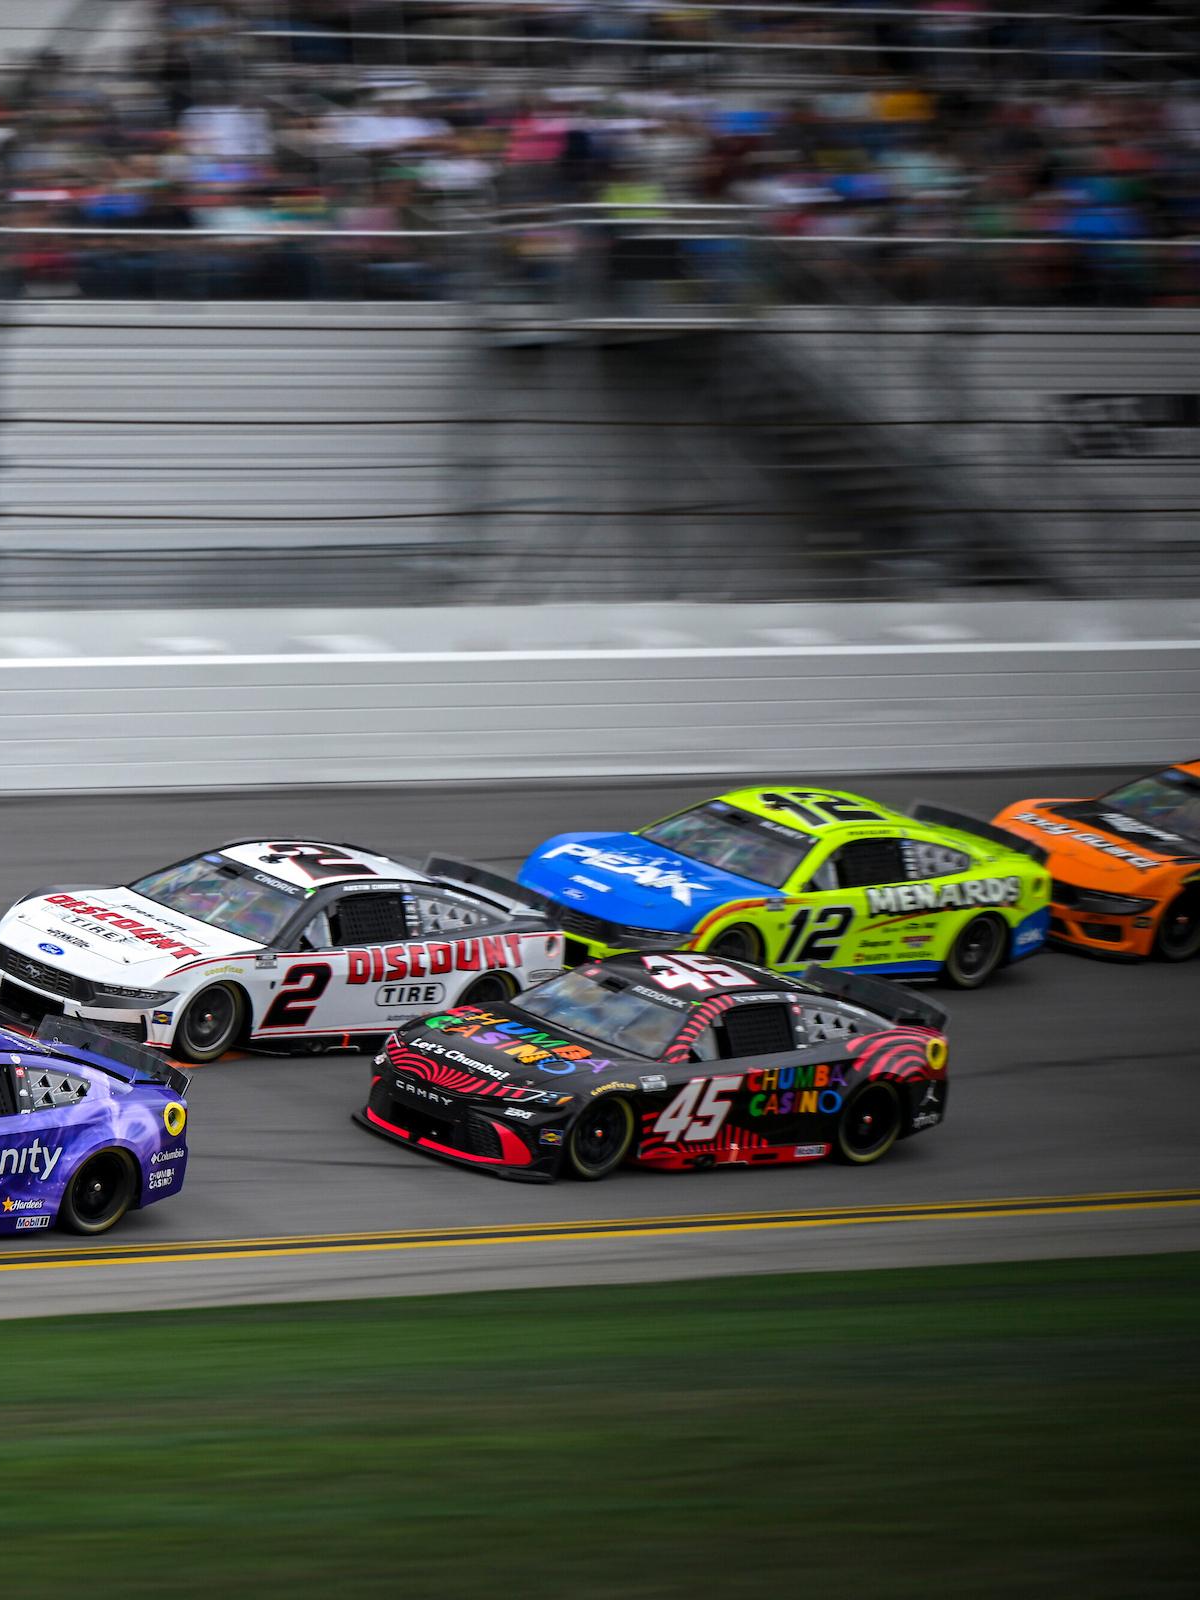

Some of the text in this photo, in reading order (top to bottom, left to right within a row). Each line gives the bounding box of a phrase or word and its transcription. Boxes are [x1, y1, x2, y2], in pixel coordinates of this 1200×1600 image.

[758, 792, 889, 829] 12
[268, 844, 379, 881] 2
[1072, 833, 1161, 870] Guard
[254, 873, 300, 895] CINDRIC
[539, 843, 713, 907] PEAK
[866, 877, 1021, 916] MENARDS
[44, 895, 202, 959] DISCOUNT
[70, 917, 118, 940] TIRE
[121, 904, 187, 931] tires.com
[775, 905, 855, 964] 12
[345, 933, 522, 984] DISCOUNT
[640, 954, 758, 990] 45
[260, 962, 332, 1029] 2
[383, 986, 436, 1003] TIRE
[631, 985, 688, 1008] REDDICK
[425, 1015, 577, 1075] CASINO
[446, 1005, 615, 1073] CHUMBA
[410, 1038, 510, 1081] Let's Chumba!
[746, 1064, 848, 1091] CHUMBA
[395, 1079, 453, 1105] CAMRY
[590, 1081, 638, 1096] GOODYEAR
[749, 1089, 843, 1117] CASINO
[652, 1074, 744, 1143] 45
[156, 1148, 184, 1162] Columbia
[149, 1177, 172, 1189] CASINO
[11, 1199, 43, 1210] Hardee's
[17, 1217, 39, 1227] Mobil
